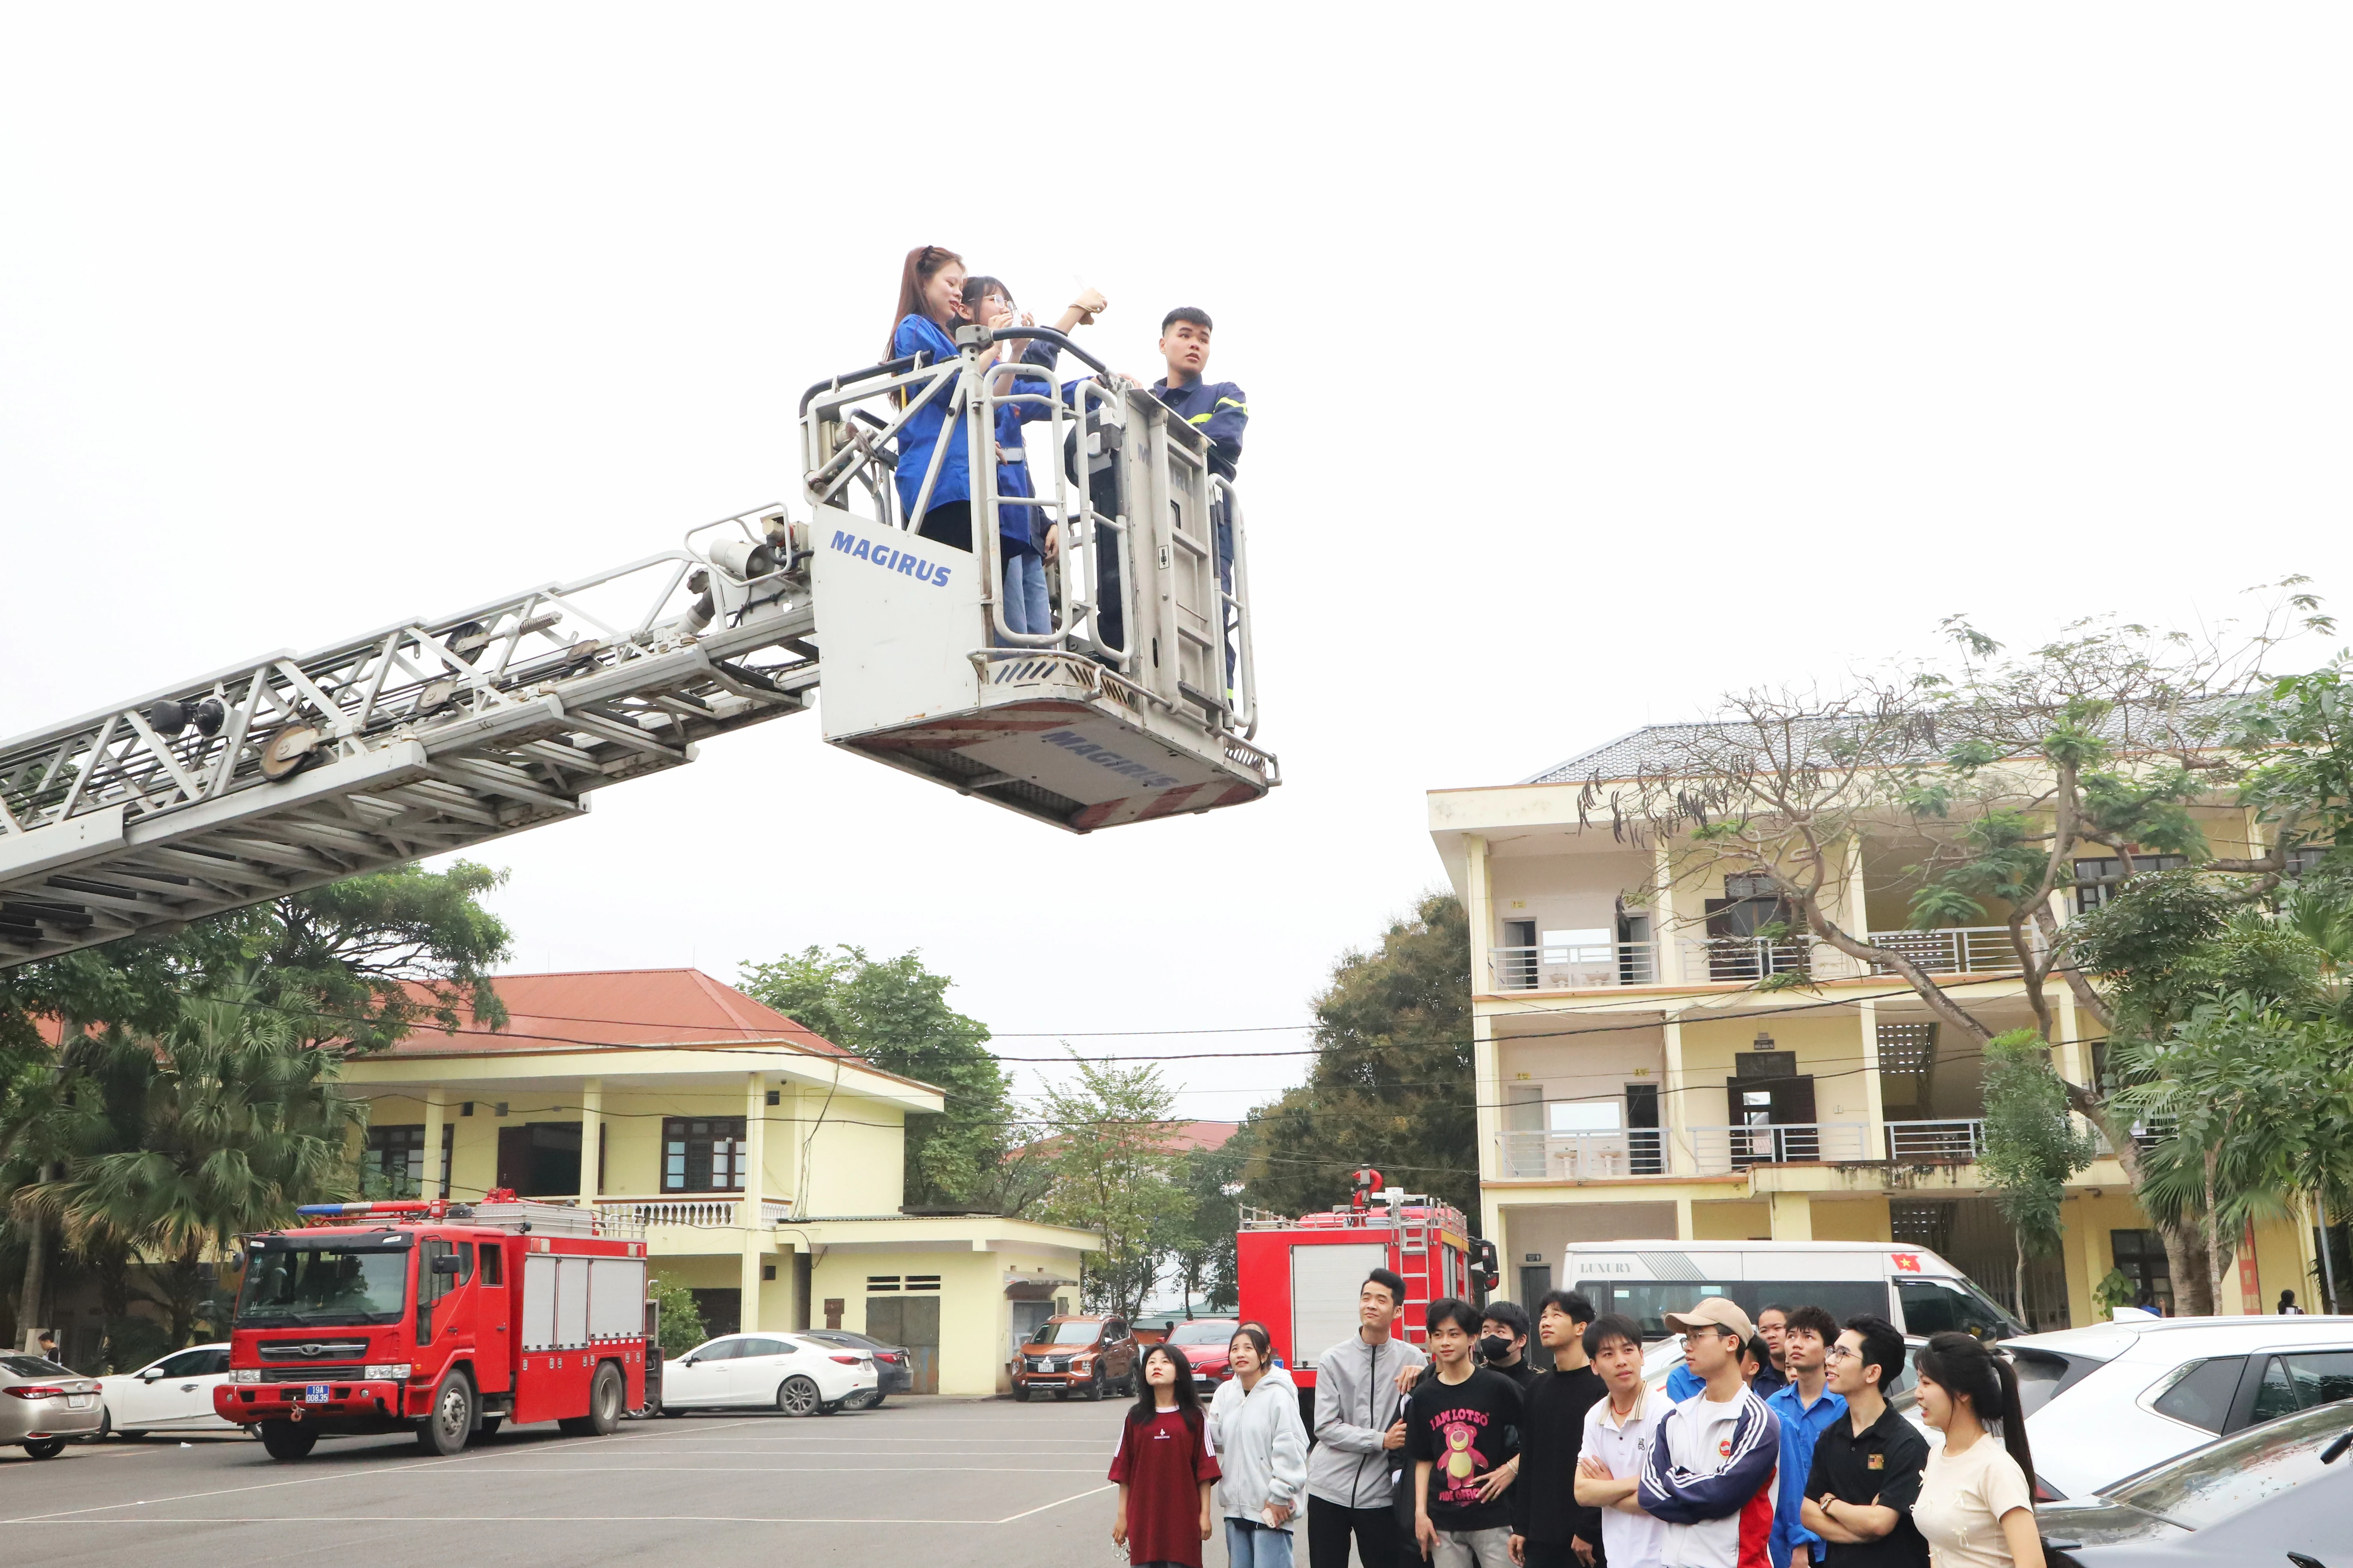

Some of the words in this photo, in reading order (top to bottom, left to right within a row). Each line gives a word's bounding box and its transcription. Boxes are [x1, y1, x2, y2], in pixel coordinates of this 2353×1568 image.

[830, 530, 951, 587] MAGIRUS
[1040, 731, 1180, 787] MAGIRUS
[1580, 1263, 1633, 1273] LUXURY
[1430, 1419, 1435, 1430] I
[1434, 1410, 1451, 1427] AM
[1452, 1409, 1488, 1426] LOTSO
[1456, 1488, 1481, 1500] OFFIC
